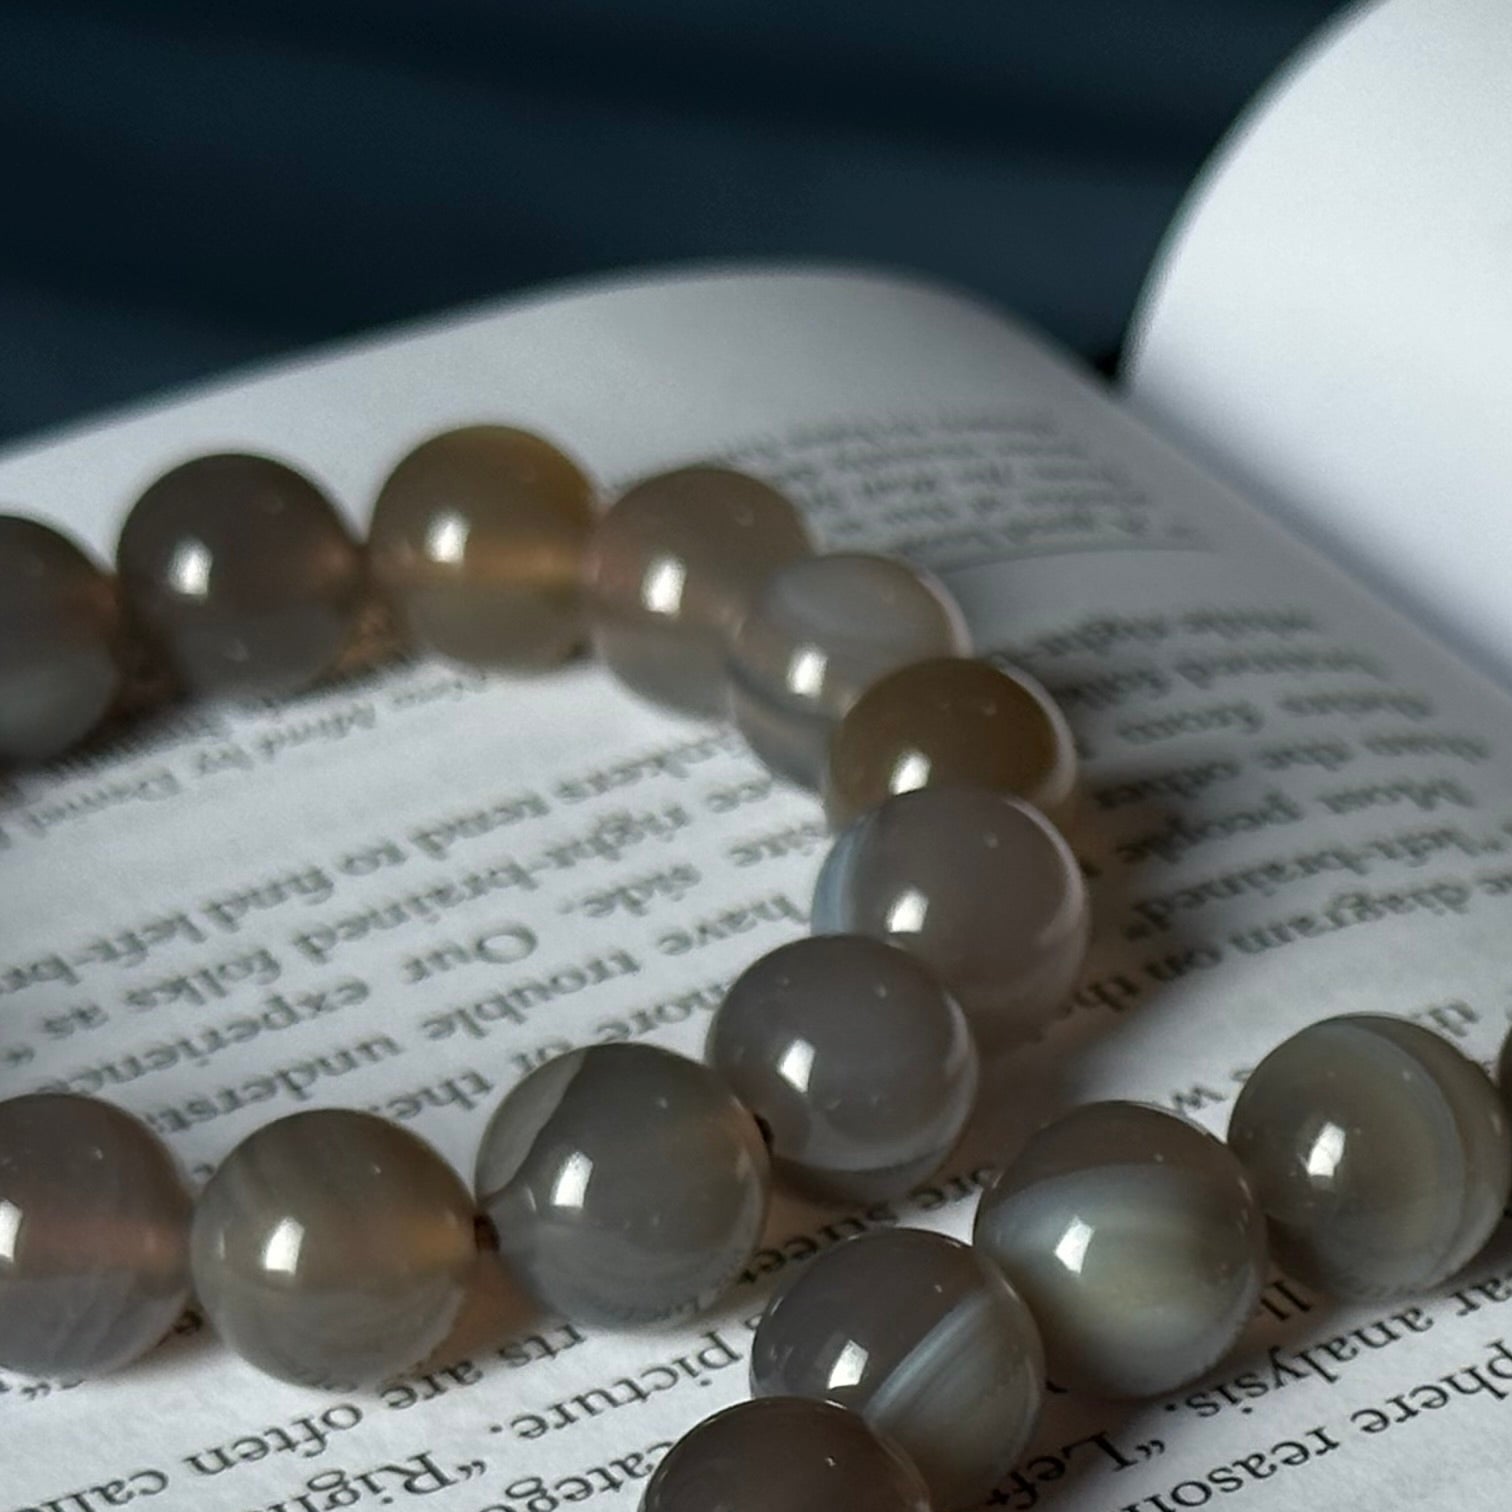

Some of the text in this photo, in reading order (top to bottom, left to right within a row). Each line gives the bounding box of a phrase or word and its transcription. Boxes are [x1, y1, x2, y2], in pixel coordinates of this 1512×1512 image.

[398, 924, 537, 984] Our
[490, 1331, 741, 1439] picture.
[1163, 1307, 1433, 1417] analysis.
[183, 1404, 362, 1475] often
